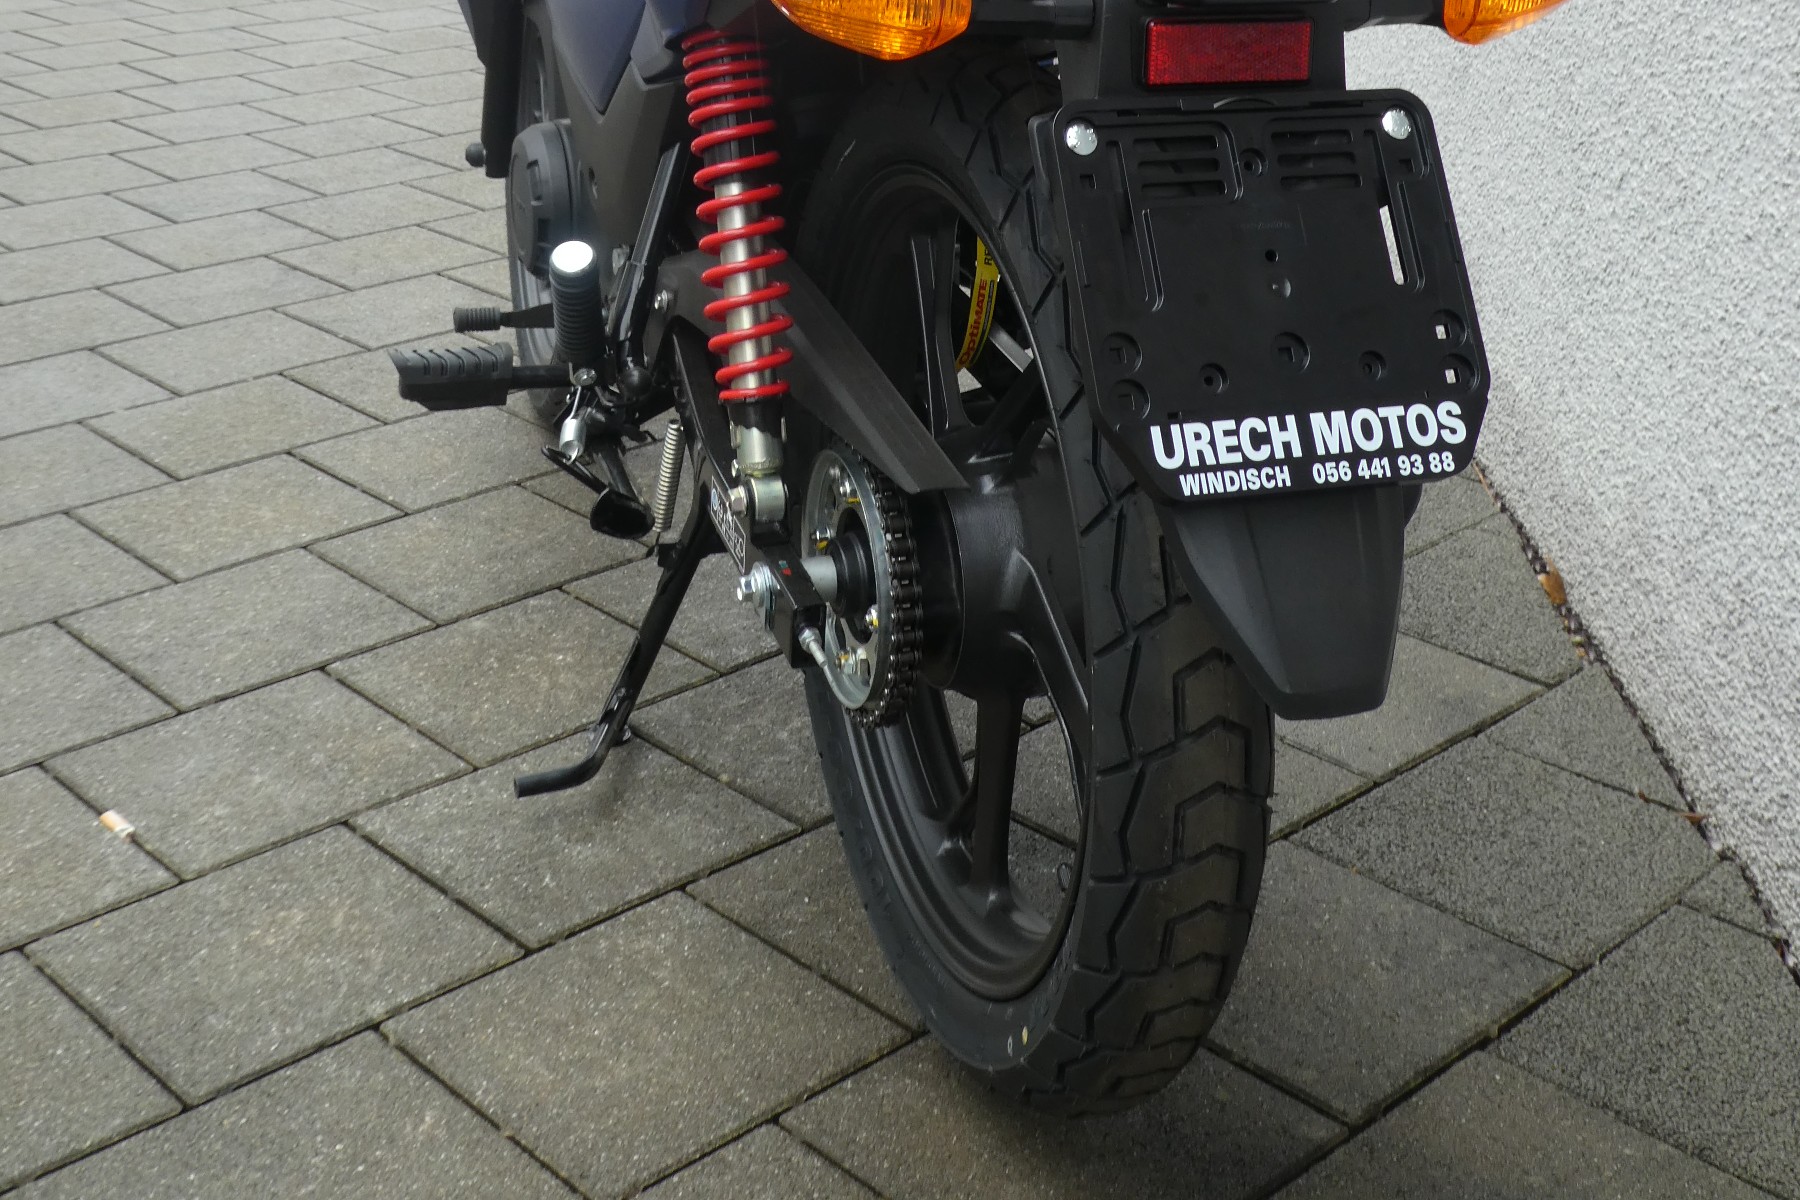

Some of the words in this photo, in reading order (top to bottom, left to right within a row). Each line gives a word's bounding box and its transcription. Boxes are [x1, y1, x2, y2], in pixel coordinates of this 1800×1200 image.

[1150, 414, 1303, 470] URECH
[1309, 400, 1467, 455] MOTOS
[1179, 464, 1292, 497] WINDISCH
[1312, 459, 1353, 484] 056
[1357, 456, 1392, 480] 441
[1397, 453, 1424, 476] 93
[1428, 450, 1455, 474] 88
